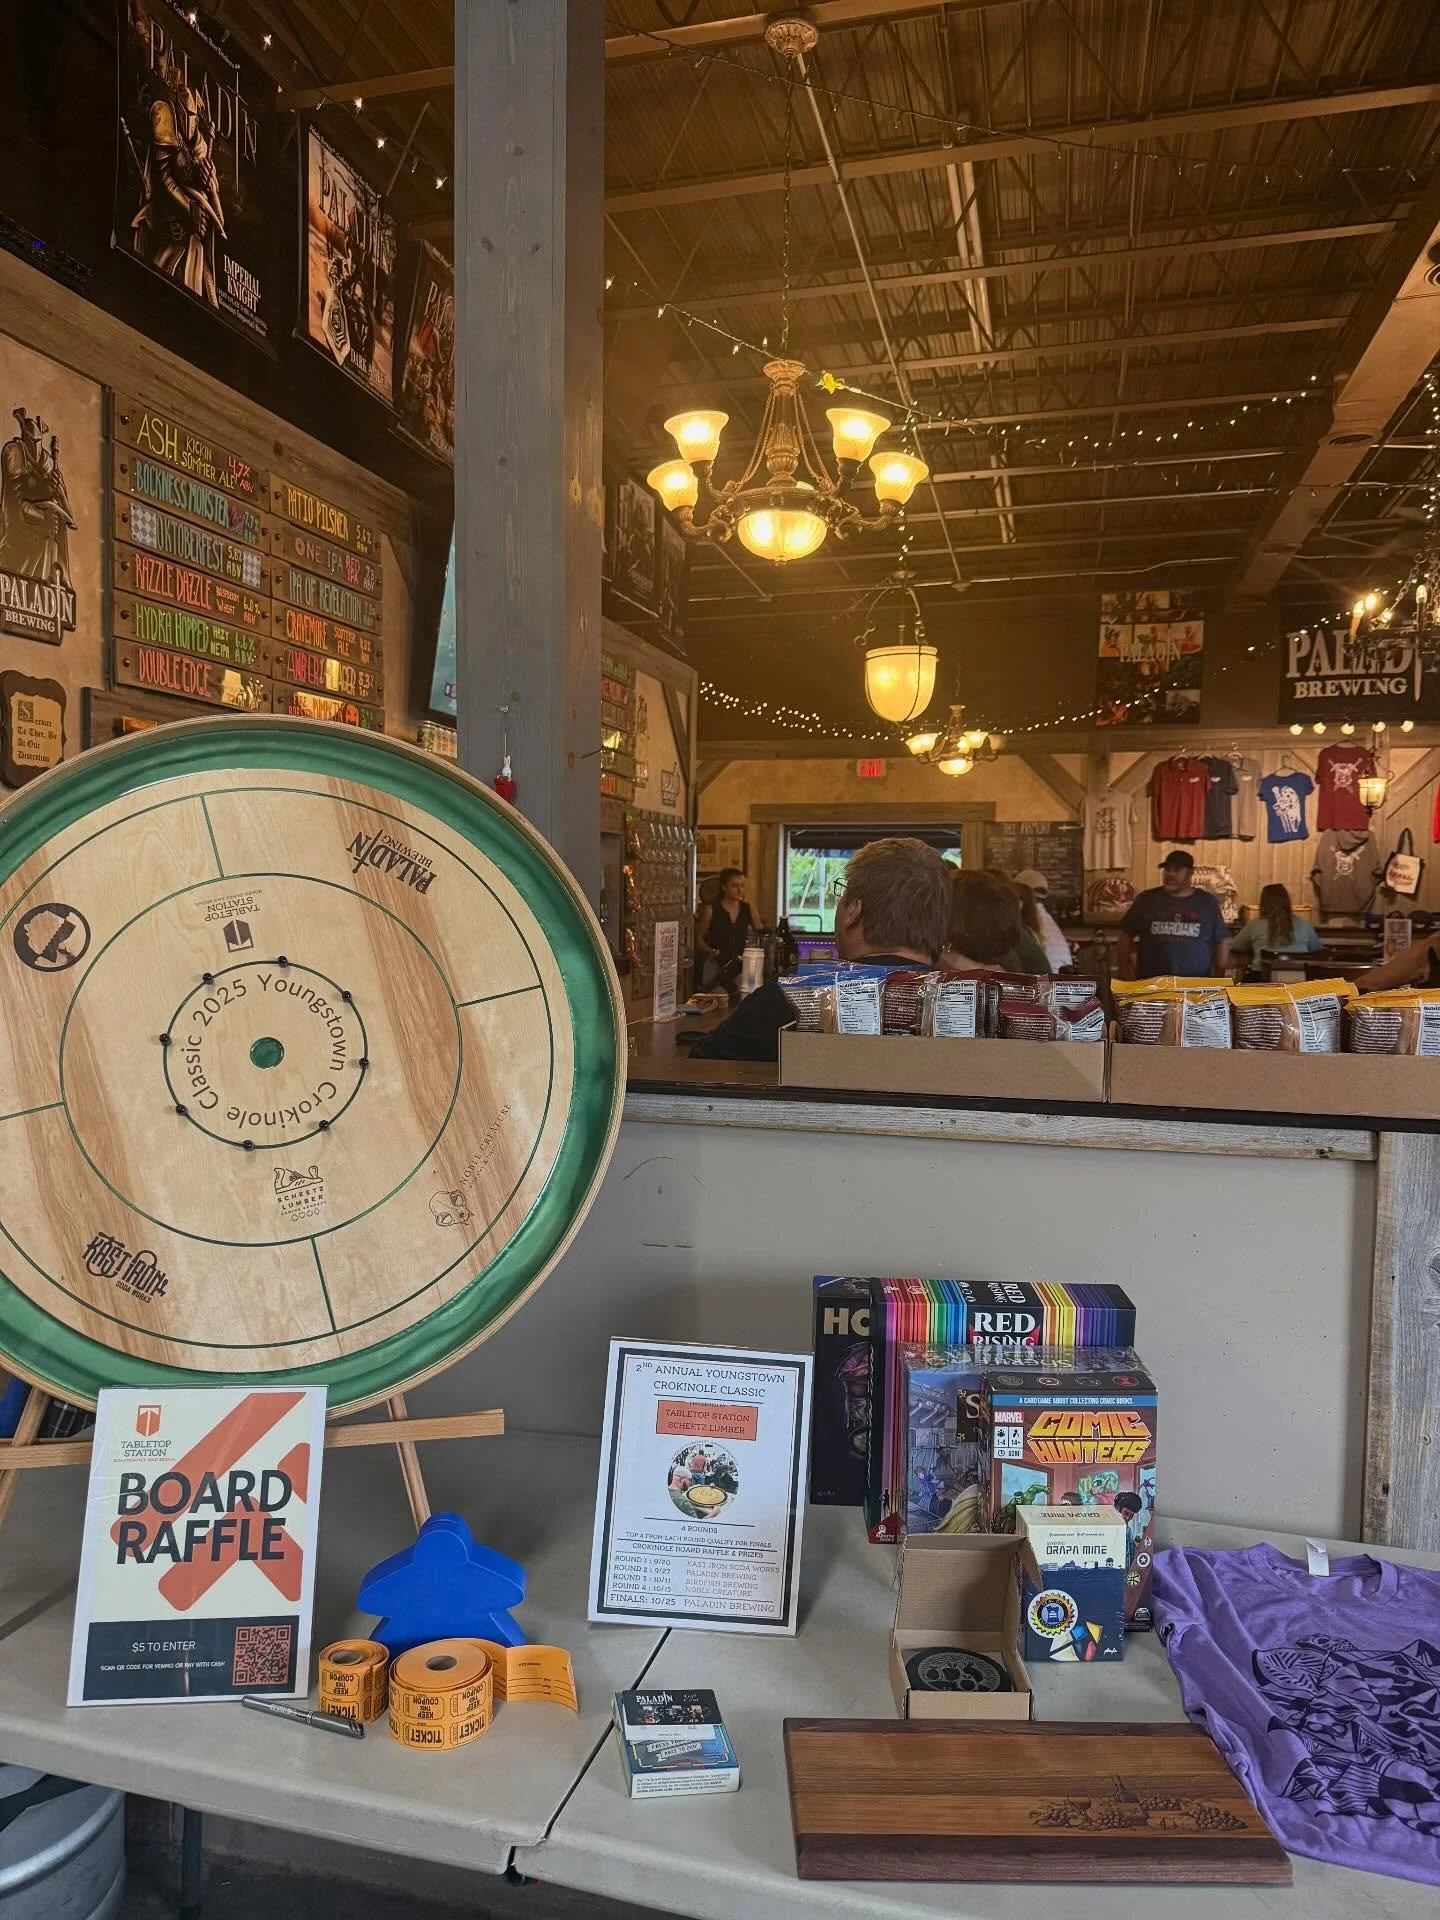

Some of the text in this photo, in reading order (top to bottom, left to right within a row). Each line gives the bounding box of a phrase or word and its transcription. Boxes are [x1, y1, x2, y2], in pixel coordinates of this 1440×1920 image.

[223, 254, 262, 299] IMPERIAL
[227, 274, 259, 313] KNIGHT
[136, 412, 178, 463] ASH
[136, 459, 229, 528] BOCKNESS MONSTER
[287, 487, 349, 542] PATIO PILSNER
[156, 515, 225, 573] OKTOBERFEST
[295, 536, 322, 564] ONE
[135, 552, 175, 598] RAZZLE
[176, 567, 213, 610] DAZZLE
[1, 571, 75, 627] PALADIN
[304, 576, 317, 608] OF
[5, 609, 56, 634] BREWING
[135, 602, 173, 644] HYDRA
[175, 611, 210, 653] HOPPED
[139, 647, 181, 690] DOUBLE
[1293, 677, 1409, 699] BREWING
[381, 835, 434, 868] BREWING
[345, 828, 437, 895] PALADIN
[204, 903, 261, 922] TABLETOP
[207, 896, 254, 912] STATION
[1150, 920, 1201, 938] GUARDIANS
[180, 973, 346, 1129] 2025 Youngstown Crokinole Classic
[459, 1104, 512, 1185] NOBLE CREATURE
[281, 1194, 324, 1210] LUMBER
[81, 1231, 168, 1297] KAST IRON
[115, 1280, 152, 1304] SODA WORKS
[987, 1282, 1008, 1303] RISING
[1001, 1282, 1026, 1304] RED
[973, 1311, 1036, 1333] RED
[972, 1334, 1035, 1346] RISING
[655, 1364, 703, 1377] ANNUAL
[706, 1368, 785, 1384] YOUNGSTOWN
[653, 1380, 766, 1398] CROKINOLE CLASSIC
[1069, 1397, 1100, 1405] COLLECTING
[1099, 1397, 1116, 1405] COMIC
[664, 1408, 750, 1423] TABLETOP STATION
[994, 1411, 1024, 1423] MARVEL
[667, 1421, 745, 1434] SCHEETZ LUMBER
[1027, 1411, 1152, 1439] COMIC
[120, 1439, 172, 1449] TABLETOP
[1027, 1438, 1151, 1464] HUNTERS
[123, 1448, 167, 1458] STATION
[117, 1469, 293, 1516] BOARD
[687, 1526, 718, 1534] ROUNDS
[116, 1517, 286, 1564] RAFFLE
[706, 1538, 734, 1546] QUALIFY
[749, 1541, 772, 1549] FINALS
[632, 1542, 674, 1552] CROKINOLE
[675, 1546, 701, 1555] BOARD
[702, 1547, 730, 1556] RAFFLE
[738, 1550, 764, 1559] PRIZES
[1082, 1545, 1108, 1555] MINE
[614, 1555, 642, 1563] ROUND
[687, 1560, 780, 1574] KAST IRON SODA WORKS
[612, 1573, 641, 1581] ROUND
[613, 1564, 671, 1575] ROUND 9/27
[686, 1569, 757, 1581] PALADIN BREWING
[611, 1582, 640, 1590] ROUND
[685, 1586, 753, 1597] NOBLE CREATURE
[722, 1581, 759, 1590] BREWING
[651, 1597, 676, 1606] 10/25
[684, 1598, 776, 1613] PALADIN BREWING
[131, 1640, 196, 1653] $5 TO ENTER
[329, 1673, 355, 1682] COUPON
[332, 1687, 349, 1695] KEEP
[462, 1683, 484, 1700] COUPON
[635, 1692, 673, 1704] PALADIN
[412, 1696, 439, 1706] COUPON
[466, 1699, 480, 1712] KEEP
[327, 1703, 357, 1719] TICKET
[417, 1711, 434, 1719] KEEP
[410, 1728, 443, 1744] TICKET
[459, 1716, 486, 1739] TICKET
